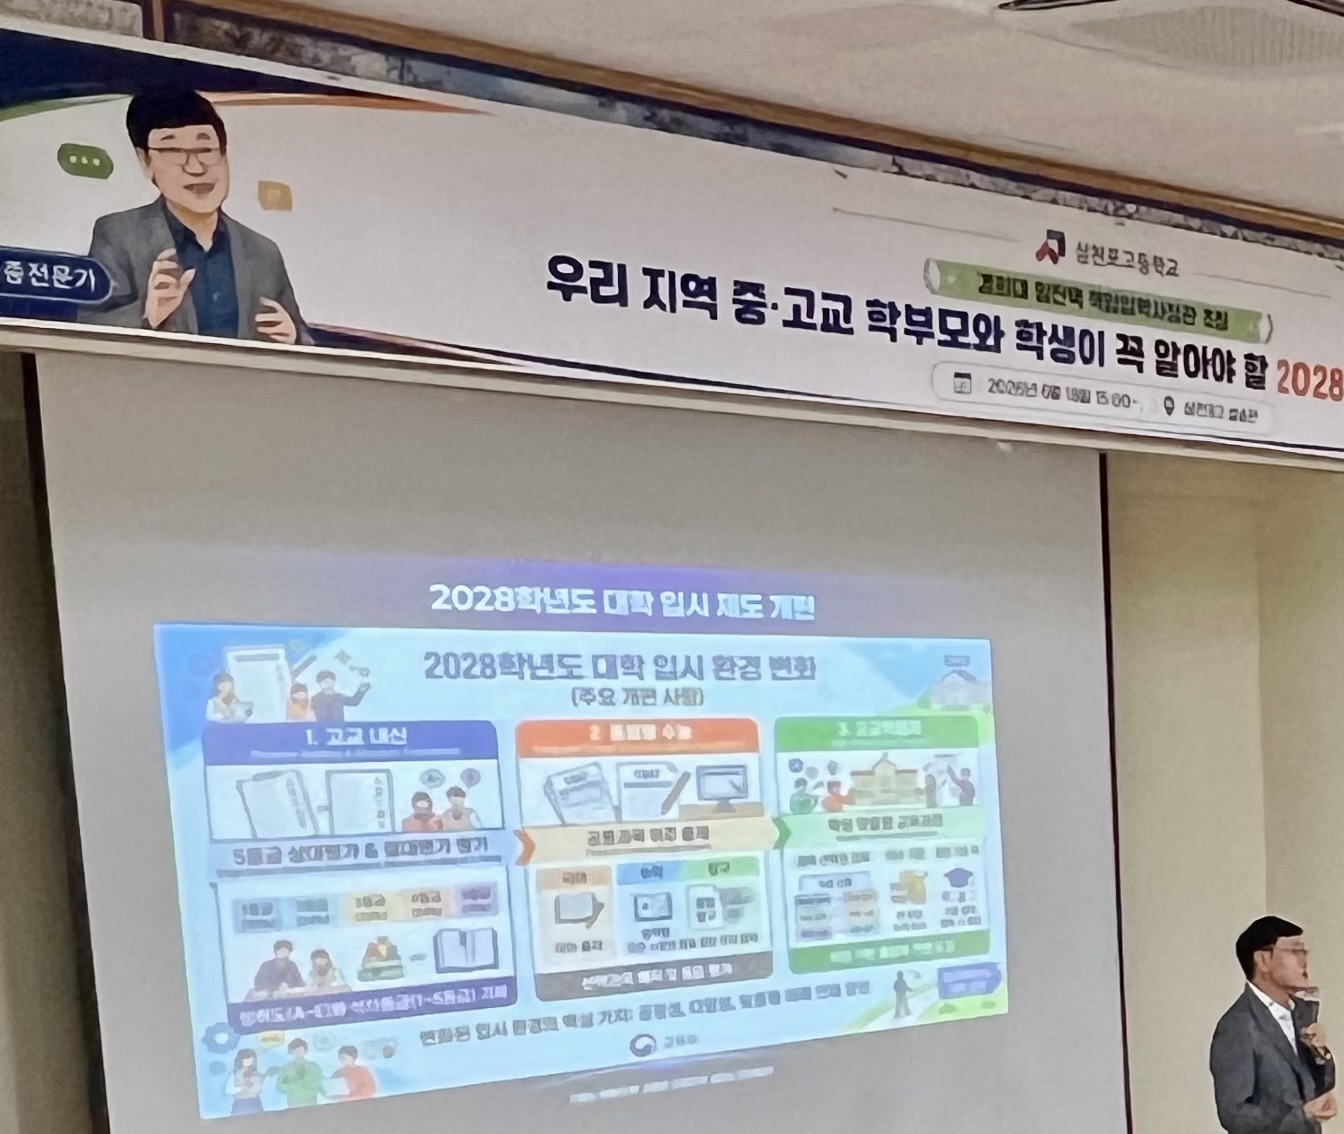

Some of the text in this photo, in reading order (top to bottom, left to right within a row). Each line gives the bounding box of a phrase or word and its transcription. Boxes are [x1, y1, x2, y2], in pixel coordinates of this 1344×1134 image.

[547, 254, 628, 308] 우리
[642, 266, 718, 321] 지역
[732, 279, 855, 336] 중·고교
[866, 298, 1005, 354] 학부모와
[1015, 318, 1105, 368] 학생이
[1115, 332, 1144, 373] 꼭
[1154, 338, 1236, 384] 알아야
[1243, 352, 1269, 391] 할
[1276, 358, 1344, 401] 2028
[429, 583, 816, 621] 2028학년도 대학 입시 제도 개편
[423, 651, 584, 681] 2028학년도
[592, 653, 645, 681] 대학
[653, 654, 704, 681] 입시
[712, 654, 762, 681] 환경
[325, 727, 364, 745] 고교
